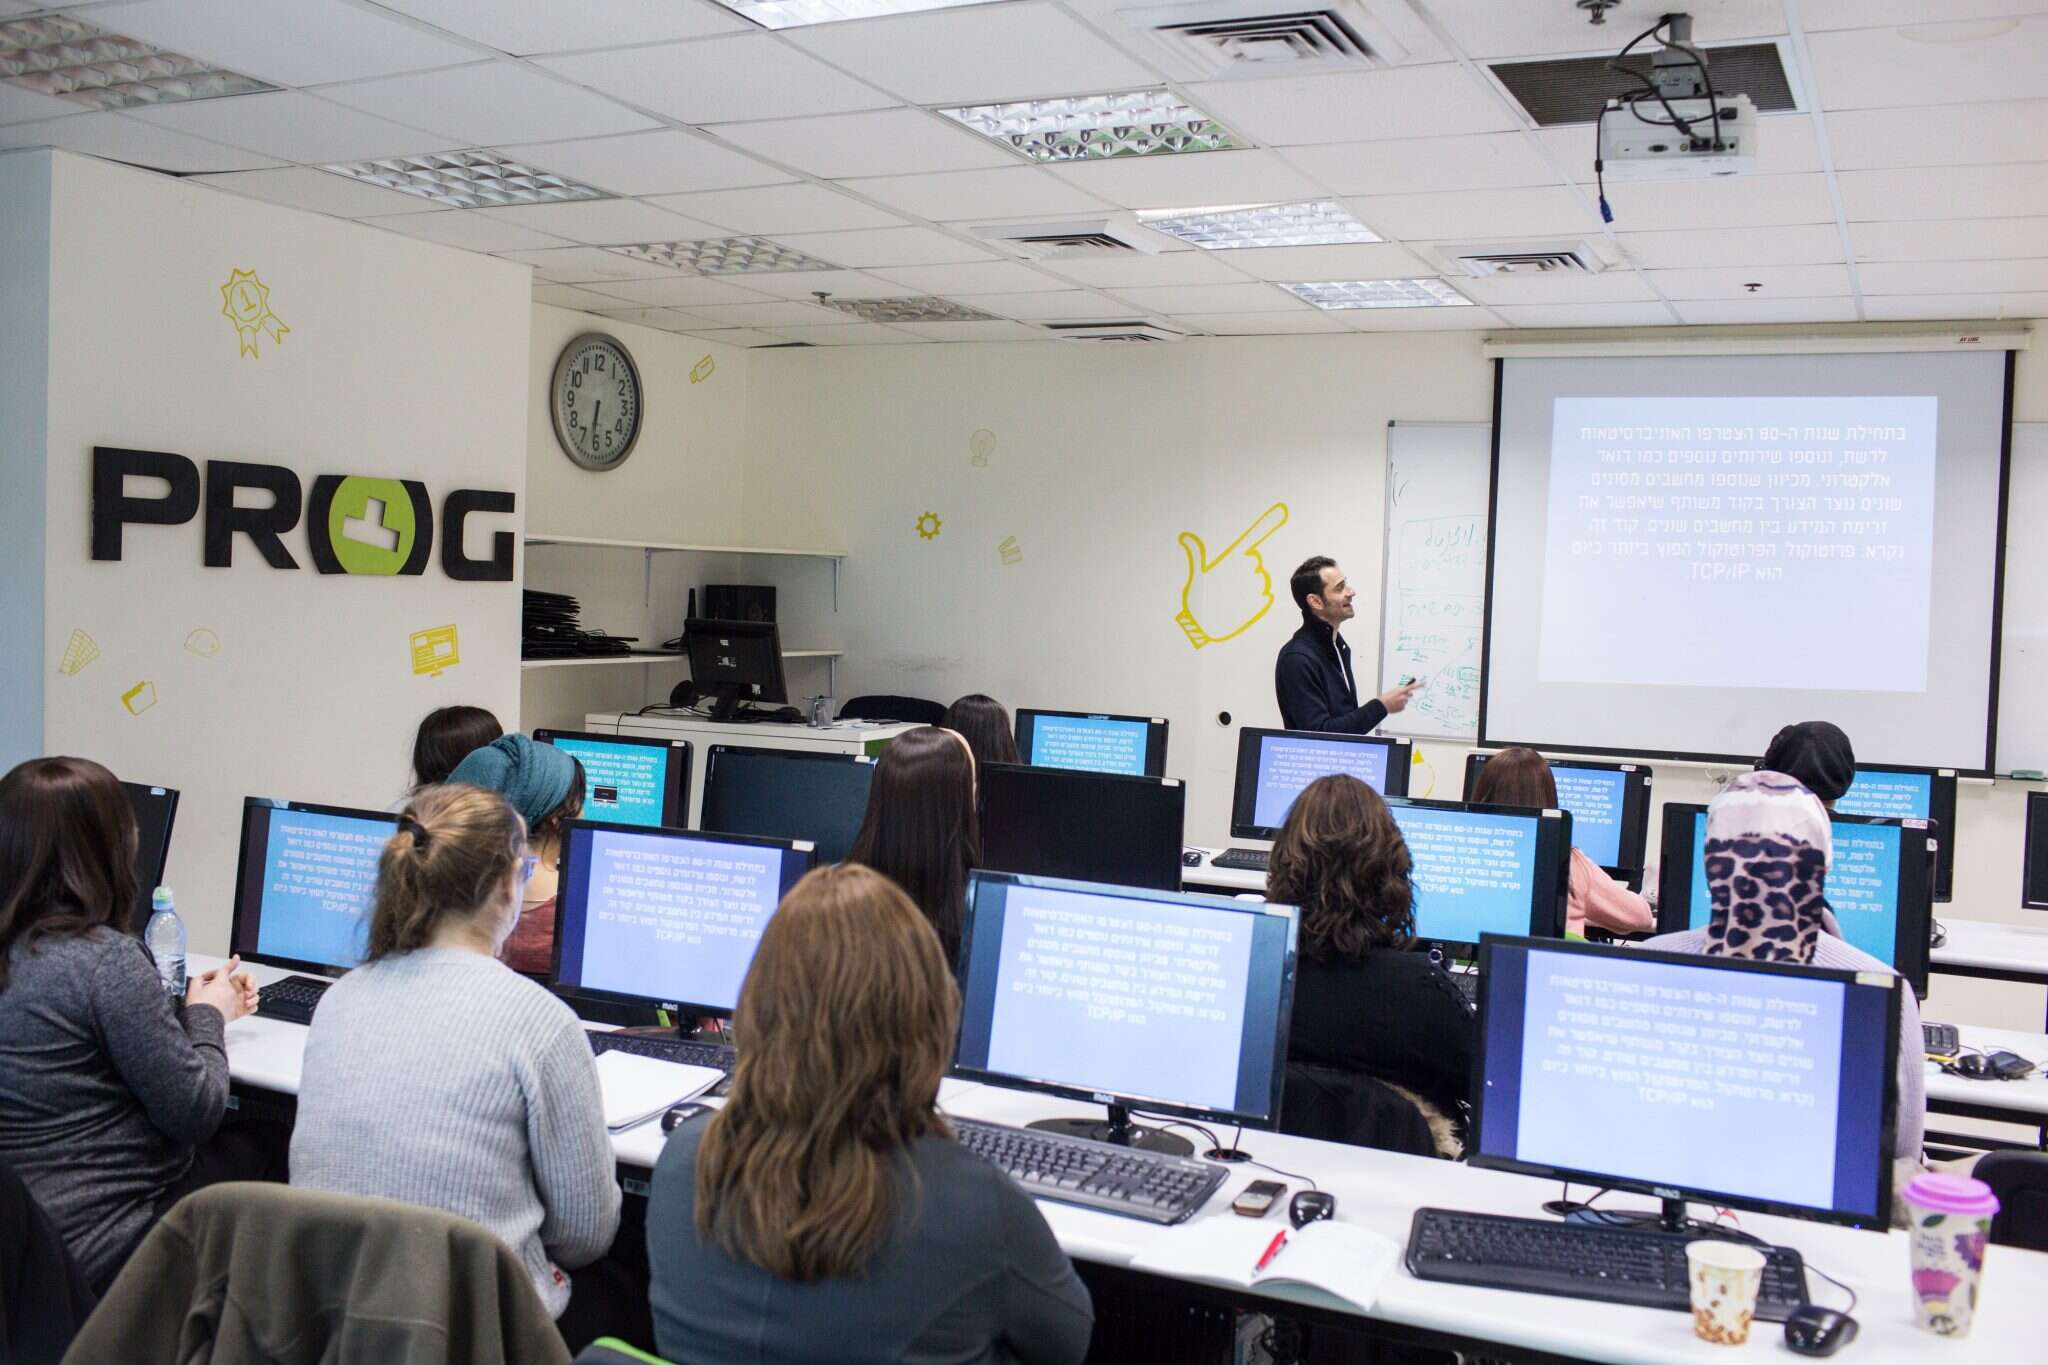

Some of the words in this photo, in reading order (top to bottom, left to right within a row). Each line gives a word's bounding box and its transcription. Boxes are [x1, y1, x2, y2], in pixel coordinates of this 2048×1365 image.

[582, 357, 589, 375] 11
[594, 354, 605, 372] 12
[571, 370, 582, 388] 10
[618, 379, 626, 396] 2
[567, 390, 575, 408] 9
[620, 399, 628, 416] 3
[570, 411, 578, 428] 8
[615, 418, 622, 435] 4
[580, 426, 587, 442] 7
[592, 434, 600, 451] 6
[605, 430, 612, 447] 5
[91, 445, 516, 582] PROG
